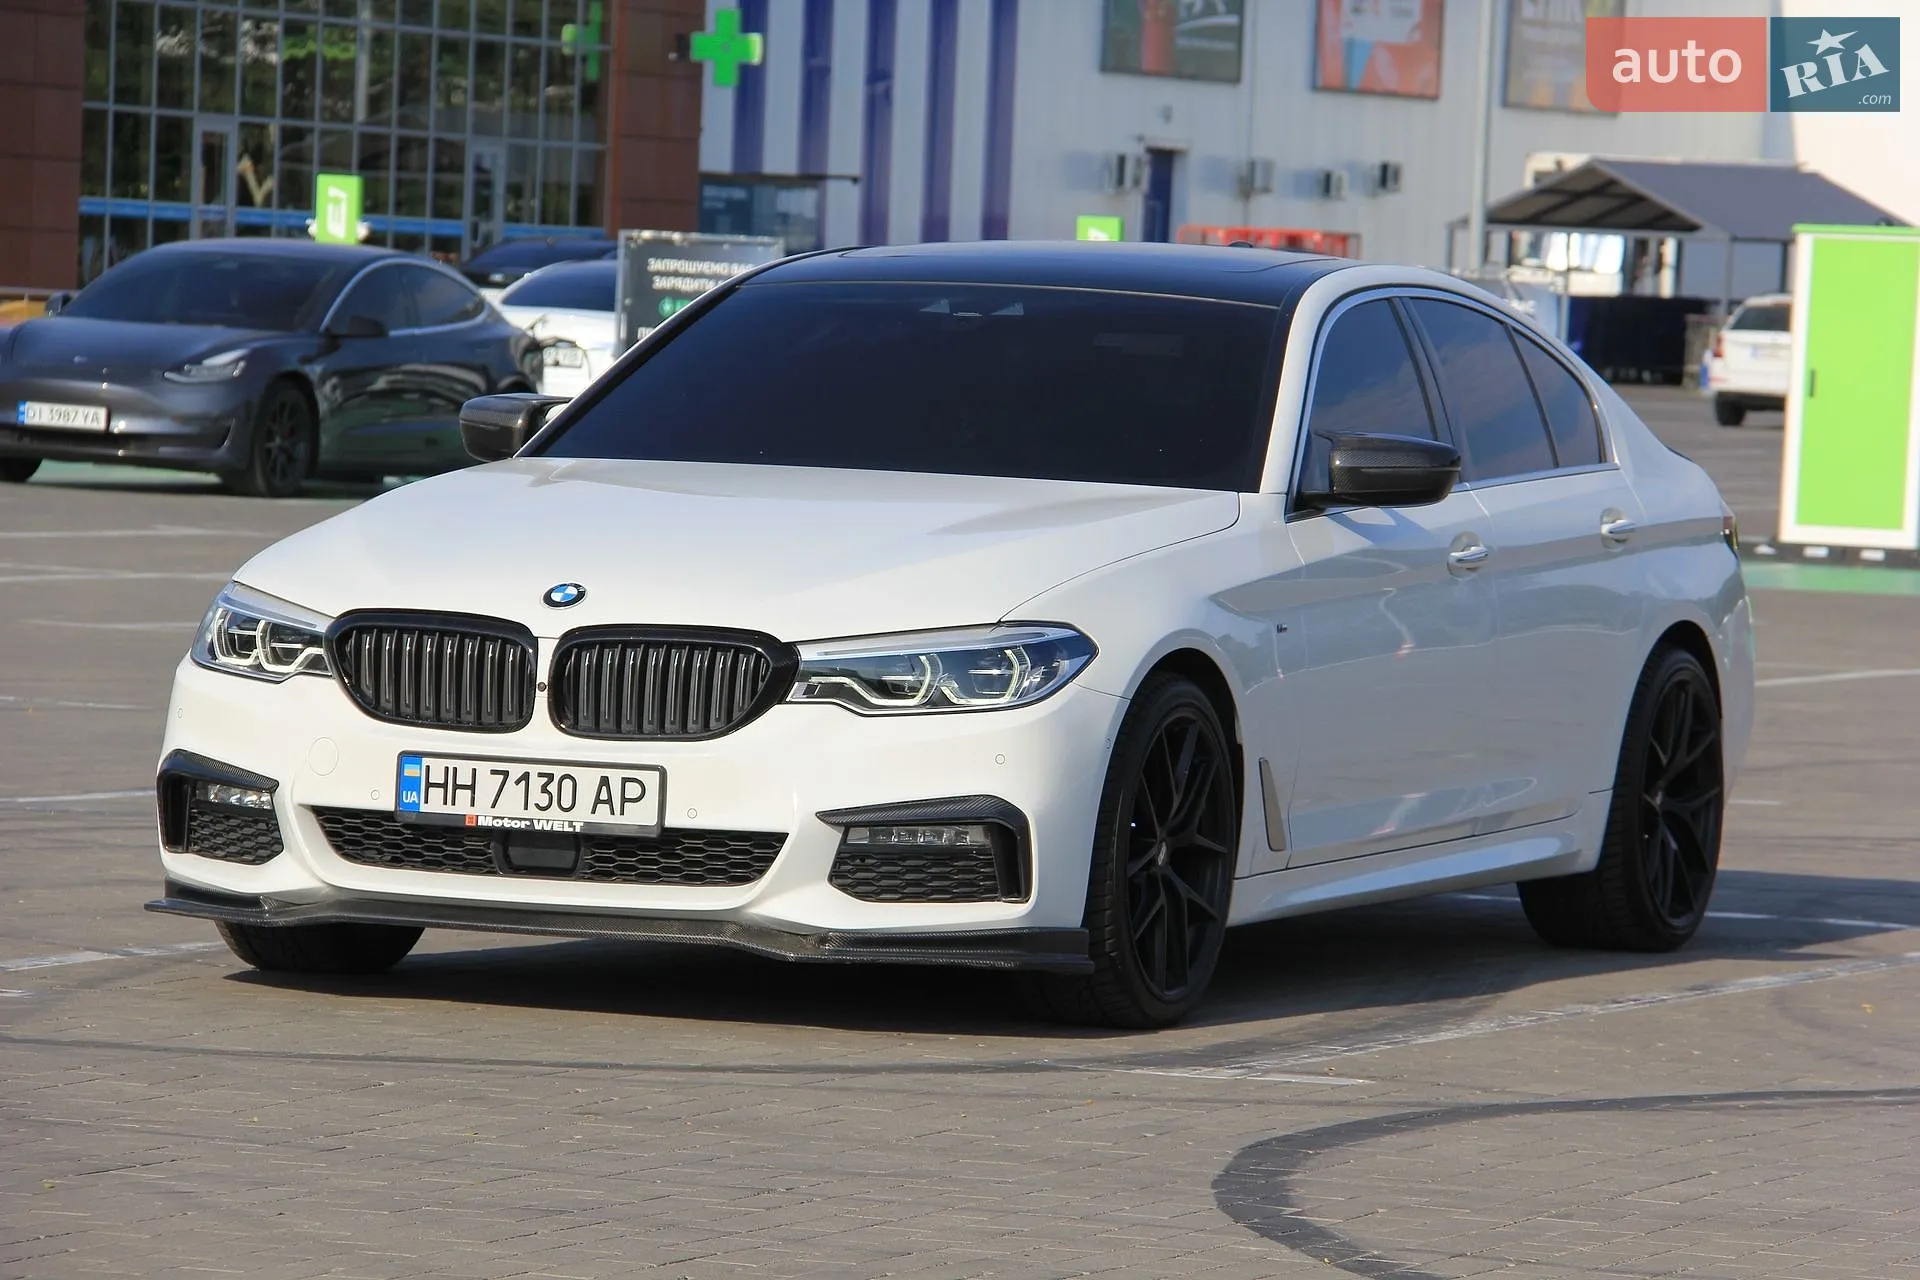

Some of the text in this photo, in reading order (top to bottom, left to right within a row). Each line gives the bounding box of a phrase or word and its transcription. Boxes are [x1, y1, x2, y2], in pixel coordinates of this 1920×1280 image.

[402, 790, 419, 804] UA
[424, 764, 647, 817] HH 7130 AP
[477, 815, 584, 833] Motor WELT
